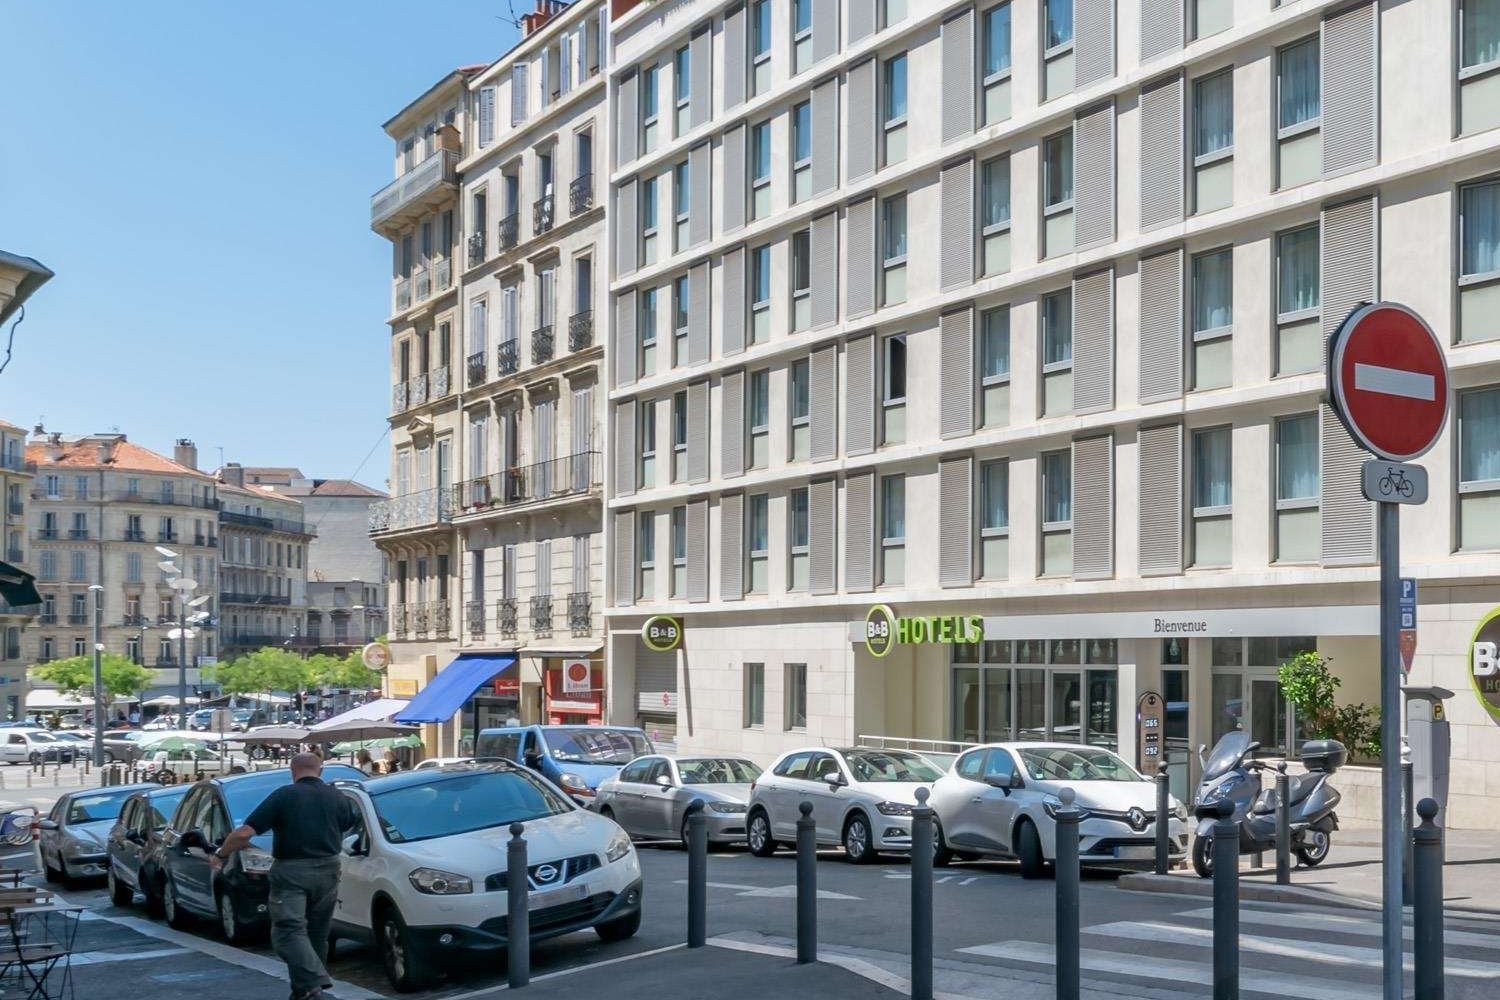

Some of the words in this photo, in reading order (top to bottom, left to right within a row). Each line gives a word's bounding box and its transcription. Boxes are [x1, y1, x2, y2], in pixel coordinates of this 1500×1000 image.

[1403, 580, 1412, 597] P
[650, 626, 677, 638] B&B
[867, 621, 889, 638] B&B
[896, 615, 984, 644] HOTELS
[1154, 618, 1207, 633] Bienvenue
